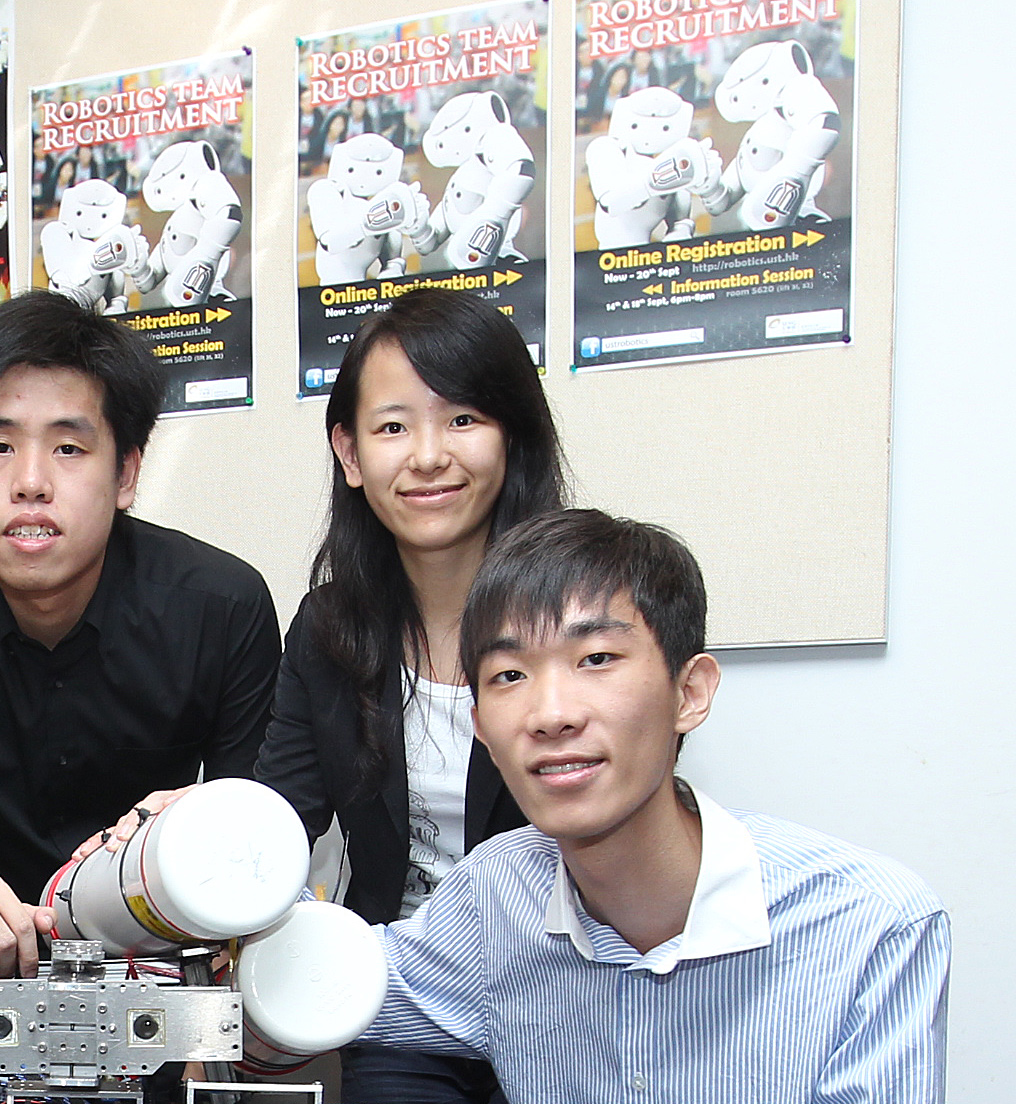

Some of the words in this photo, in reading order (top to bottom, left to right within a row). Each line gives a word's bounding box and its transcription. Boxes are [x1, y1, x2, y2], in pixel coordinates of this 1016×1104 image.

[590, 0, 741, 28] ROBOT
[590, 0, 837, 56] RECRUITMENT
[311, 33, 450, 78] ROBOTICS
[458, 20, 538, 51] TEAM
[311, 44, 536, 104] RECRUITMENT
[43, 85, 166, 126] ROBOTICS
[172, 74, 244, 103] TEAM
[43, 97, 243, 151] RECRUITMENT
[599, 249, 663, 270] Online
[666, 234, 786, 263] Registration
[692, 252, 800, 273] http://robotics.ust.hk
[604, 272, 627, 284] Now
[658, 266, 680, 278] Sept
[671, 273, 760, 294] Information
[763, 267, 814, 284] Session
[320, 285, 378, 306] Online
[622, 300, 630, 310] &
[726, 288, 750, 298] room
[752, 285, 774, 295] 5620
[325, 307, 347, 318] Now
[183, 339, 224, 355] Session
